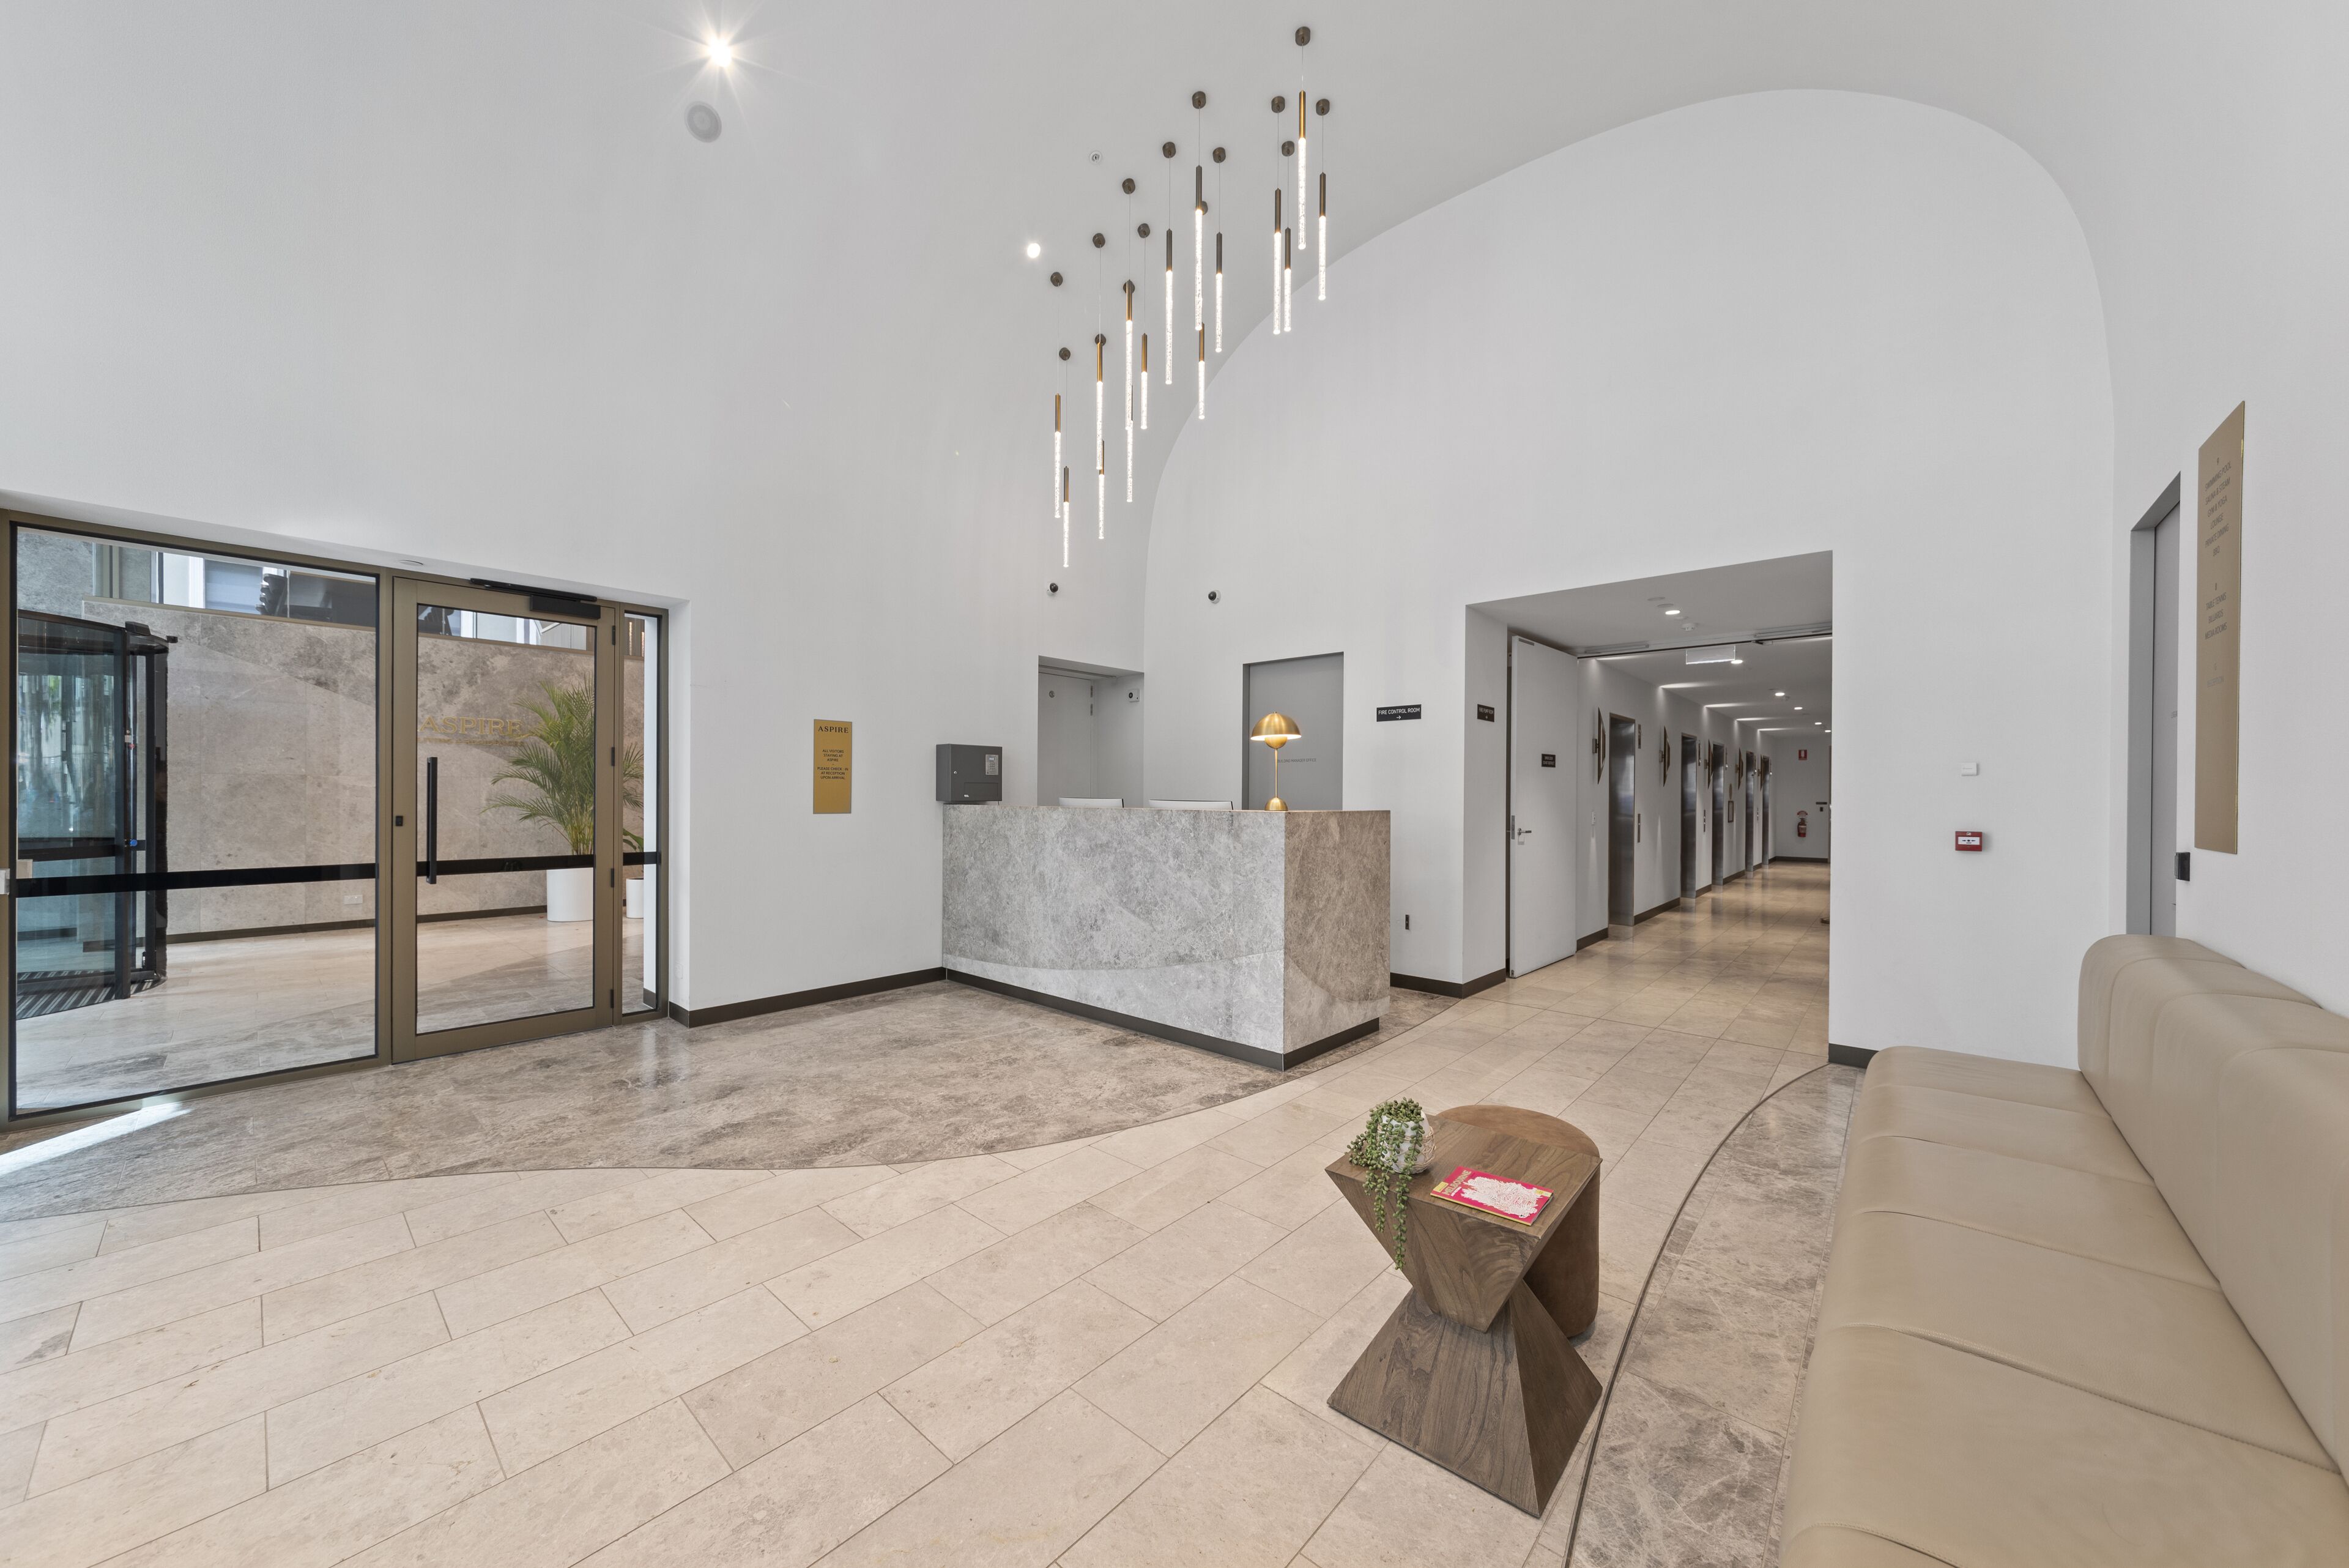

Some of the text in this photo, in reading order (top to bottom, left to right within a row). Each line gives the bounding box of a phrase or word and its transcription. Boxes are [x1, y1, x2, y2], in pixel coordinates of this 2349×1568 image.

[2205, 461, 2232, 491] SWIMMING POOL
[2205, 489, 2216, 505] SAUNA
[2219, 477, 2230, 492] STEAM
[2217, 494, 2227, 508] YOGA
[2210, 513, 2224, 530] LOUNGE
[2205, 523, 2229, 548] PRIVATE DINING
[2206, 592, 2227, 611] TABLE TENNIS
[2208, 609, 2224, 624] BILLIARDS
[2205, 622, 2227, 639] MEDIA ROOMS
[418, 715, 523, 735] ASPIRE
[1441, 1170, 1472, 1195] MELBOURNE
